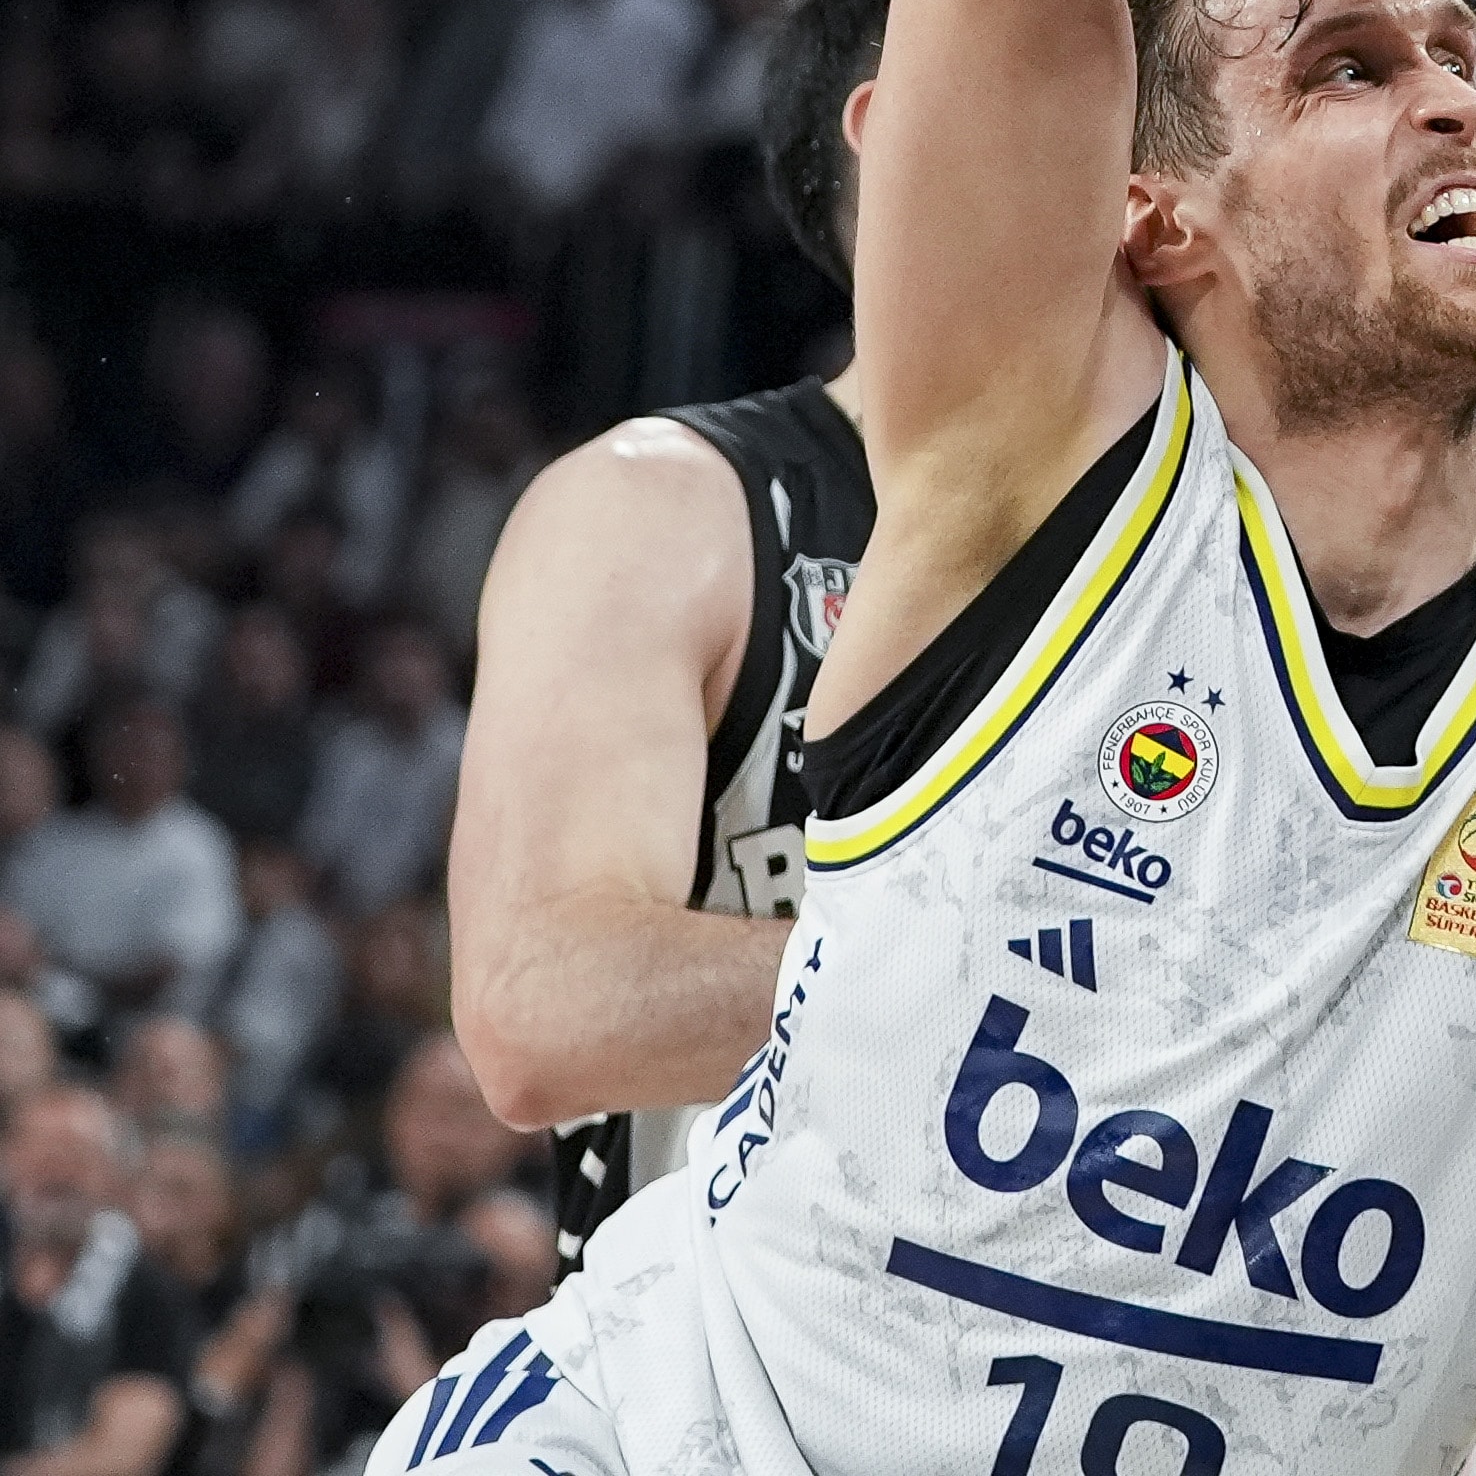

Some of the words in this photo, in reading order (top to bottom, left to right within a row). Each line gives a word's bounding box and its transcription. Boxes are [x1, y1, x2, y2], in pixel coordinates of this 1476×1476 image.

[1103, 706, 1176, 771] FENERBAHÇE
[1180, 714, 1212, 752] SPOR
[1050, 798, 1173, 890] beko
[1119, 792, 1151, 814] 1907
[708, 937, 824, 1229] CADEMY
[944, 994, 1425, 1319] beko
